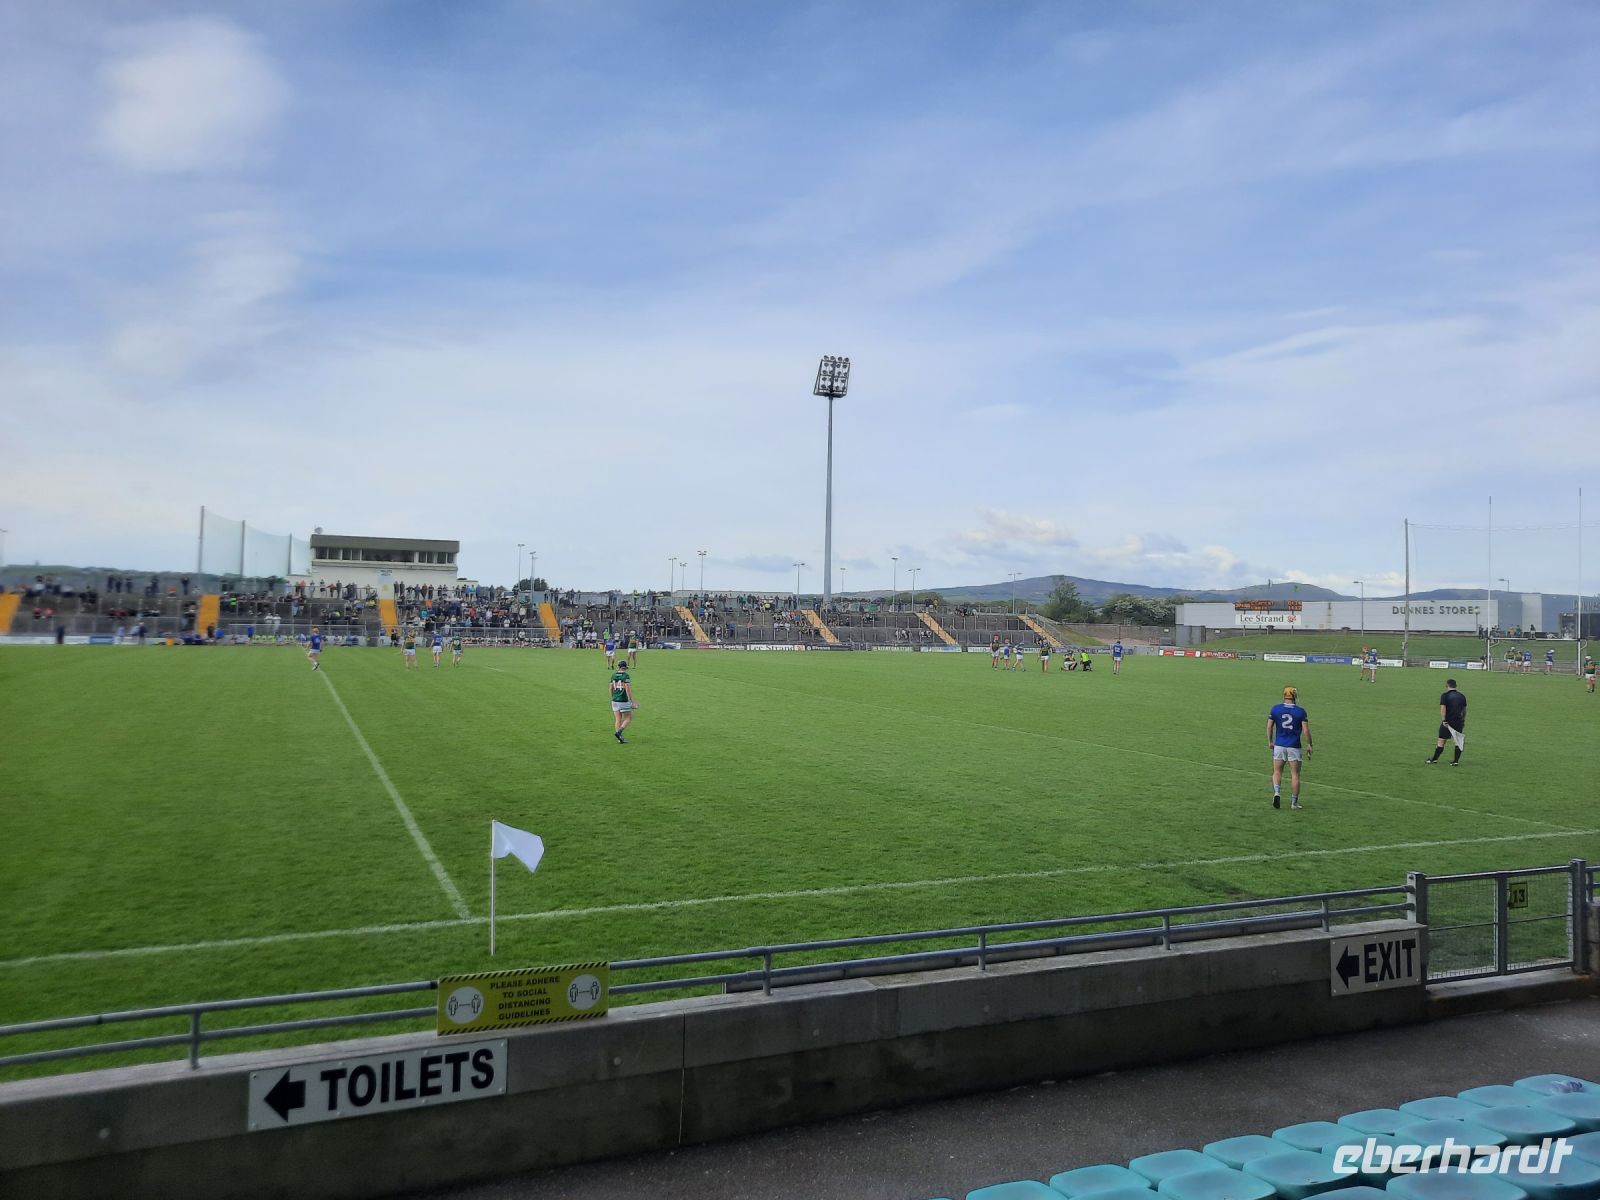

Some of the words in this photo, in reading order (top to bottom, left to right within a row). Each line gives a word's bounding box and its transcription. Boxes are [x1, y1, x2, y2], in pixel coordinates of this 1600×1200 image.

[1392, 606, 1434, 615] DUNNES
[1439, 605, 1480, 615] STORES
[1255, 615, 1284, 623] Strand
[612, 679, 624, 691] 14
[1281, 713, 1294, 730] 2
[1513, 888, 1525, 903] 13
[1363, 938, 1417, 984] EXIT
[490, 981, 523, 990] PLEASE
[526, 975, 561, 986] ADHERE
[517, 988, 548, 998] SOCIAL
[498, 998, 551, 1010] DISTANCING
[498, 1009, 551, 1021] GUIDELINES
[320, 1049, 495, 1111] TOILETS
